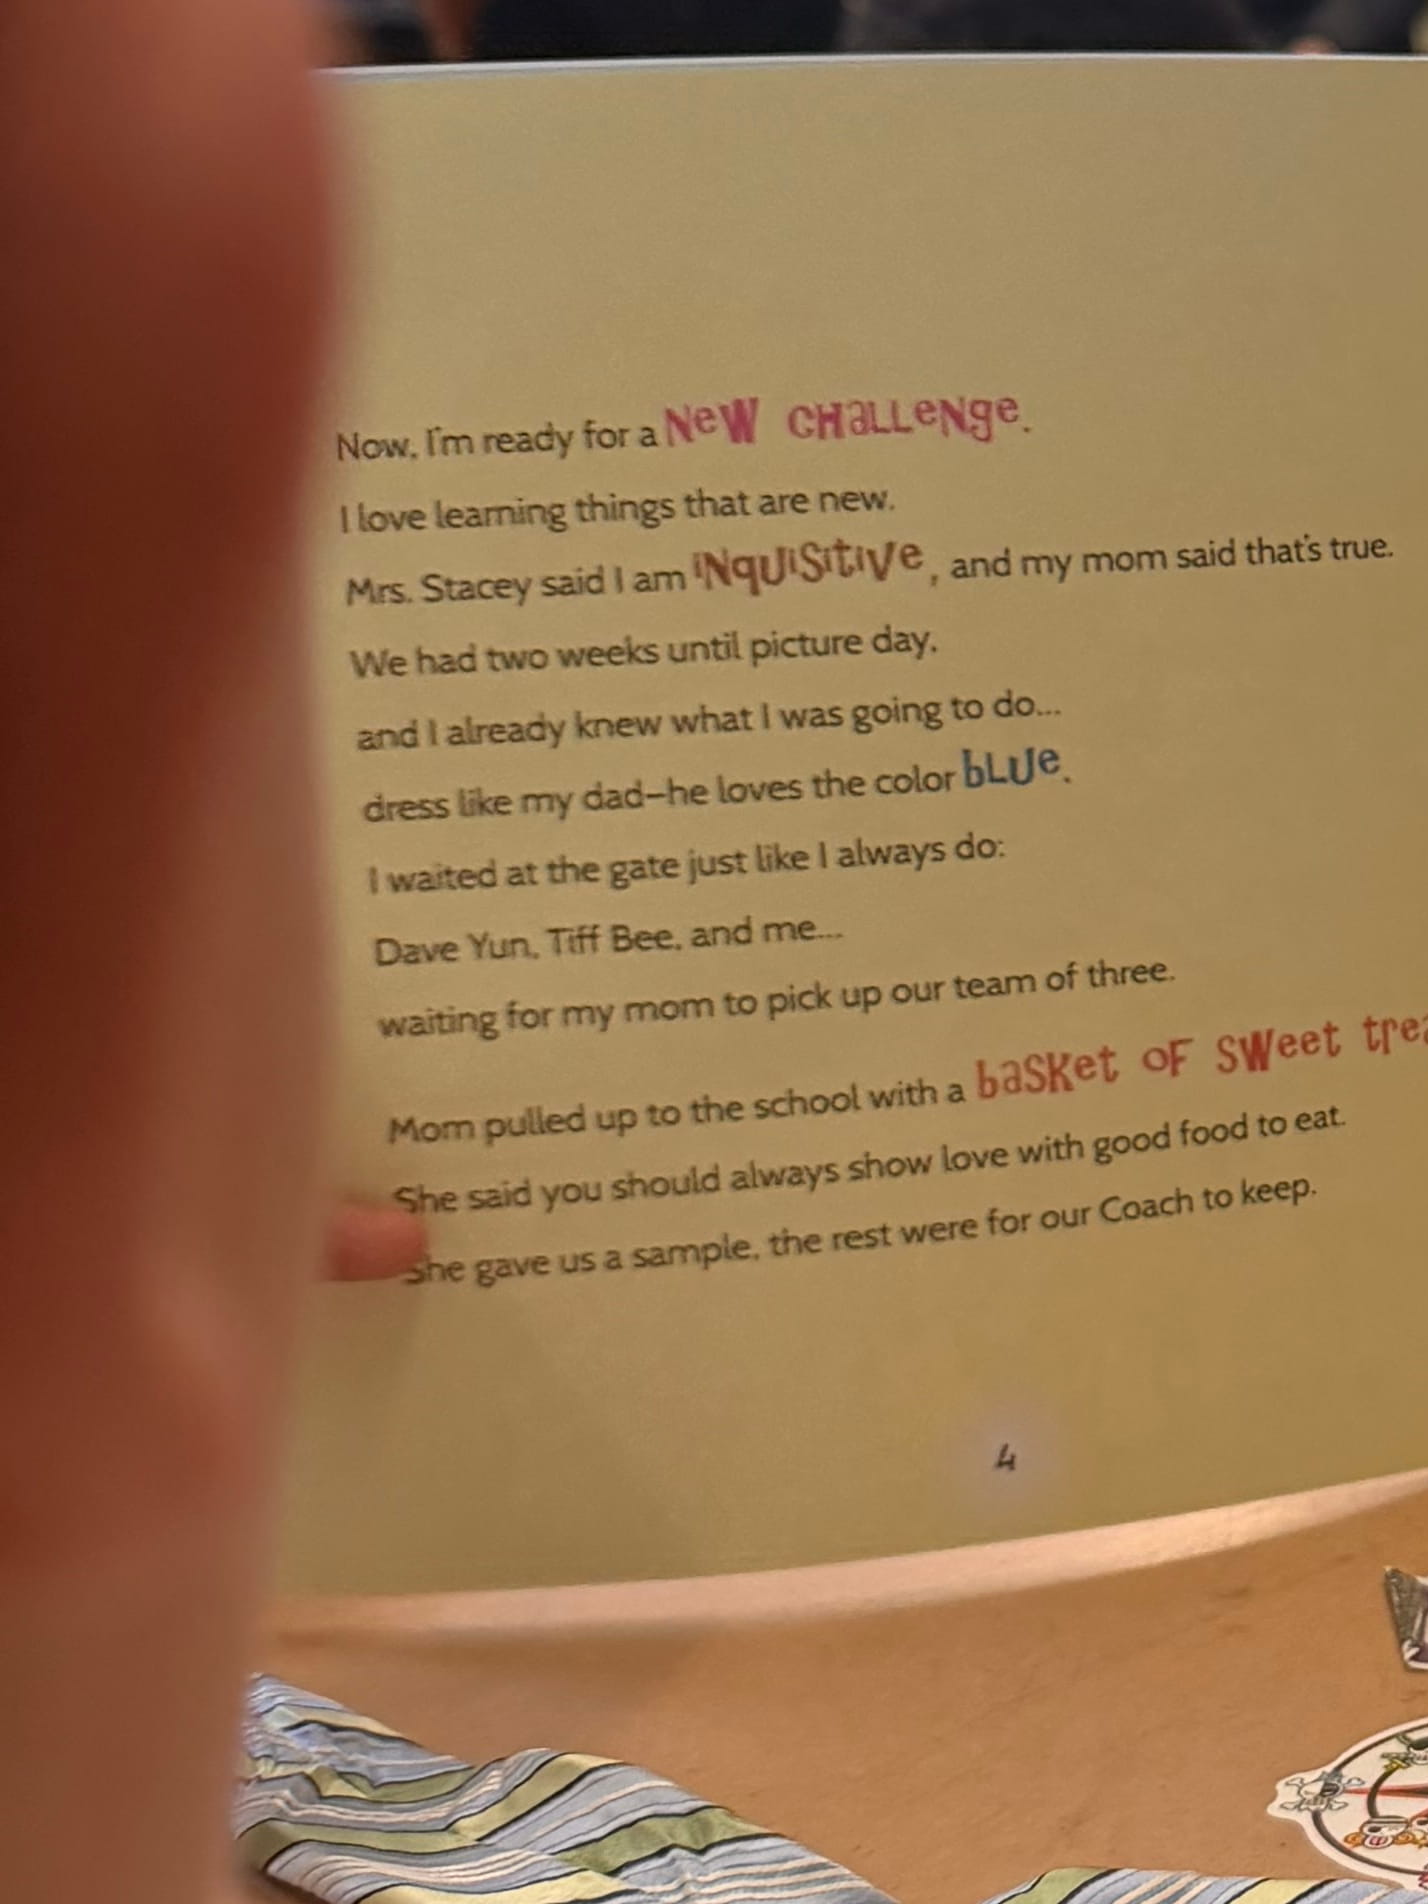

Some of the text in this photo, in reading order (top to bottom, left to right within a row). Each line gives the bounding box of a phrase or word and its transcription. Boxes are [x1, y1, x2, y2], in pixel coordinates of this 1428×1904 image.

[481, 420, 576, 461] ready
[581, 418, 632, 451] for
[636, 425, 660, 449] a
[340, 486, 896, 535] I love learning things that are new.
[345, 576, 415, 607] Mrs.
[418, 572, 534, 608] Stacey
[538, 563, 607, 598] said
[613, 565, 625, 595] I
[631, 569, 688, 594] am
[949, 545, 1013, 580] and
[1019, 553, 1074, 585] my
[1081, 548, 1169, 574] mom
[1175, 536, 1237, 570] said
[1243, 532, 1323, 567] that's
[1327, 536, 1394, 562] true.
[348, 623, 939, 680] We had two weeks until picture day.
[355, 717, 421, 753] and
[426, 717, 441, 747] I
[444, 711, 568, 750] already
[572, 709, 663, 741] knew
[668, 703, 756, 736] what
[759, 701, 772, 731] I
[776, 705, 845, 731] was
[850, 695, 945, 736] going
[948, 695, 985, 722] to
[360, 791, 452, 824] dress
[455, 786, 514, 819] like
[517, 791, 576, 823] my
[715, 773, 805, 805] loves
[809, 767, 867, 801] the
[872, 763, 958, 796] color
[367, 830, 1006, 896] I waited at the gate just like I always do:
[372, 937, 461, 968] Dave
[543, 923, 603, 958] Tiff
[689, 914, 754, 949] and
[376, 957, 1177, 1043] waiting for my mom to pick up our team of three.
[386, 1115, 477, 1146] Mom
[481, 1102, 588, 1149] pulled
[594, 1107, 639, 1139] up
[644, 1103, 683, 1129] to
[687, 1093, 745, 1126] the
[751, 1081, 863, 1121] school
[866, 1076, 939, 1111] with
[943, 1082, 968, 1105] a
[391, 1104, 1347, 1216] She said you should always show love with good food to eat.
[472, 1255, 553, 1290] gave
[557, 1251, 598, 1276] us
[601, 1249, 625, 1273] a
[767, 1226, 824, 1259] the
[829, 1222, 894, 1253] rest
[897, 1218, 980, 1246] were
[984, 1206, 1033, 1237] for
[1037, 1205, 1093, 1232] our
[1097, 1186, 1195, 1225] Coach
[1201, 1187, 1235, 1213] to
[1239, 1177, 1318, 1207] keep.
[992, 1443, 1018, 1472] 4
